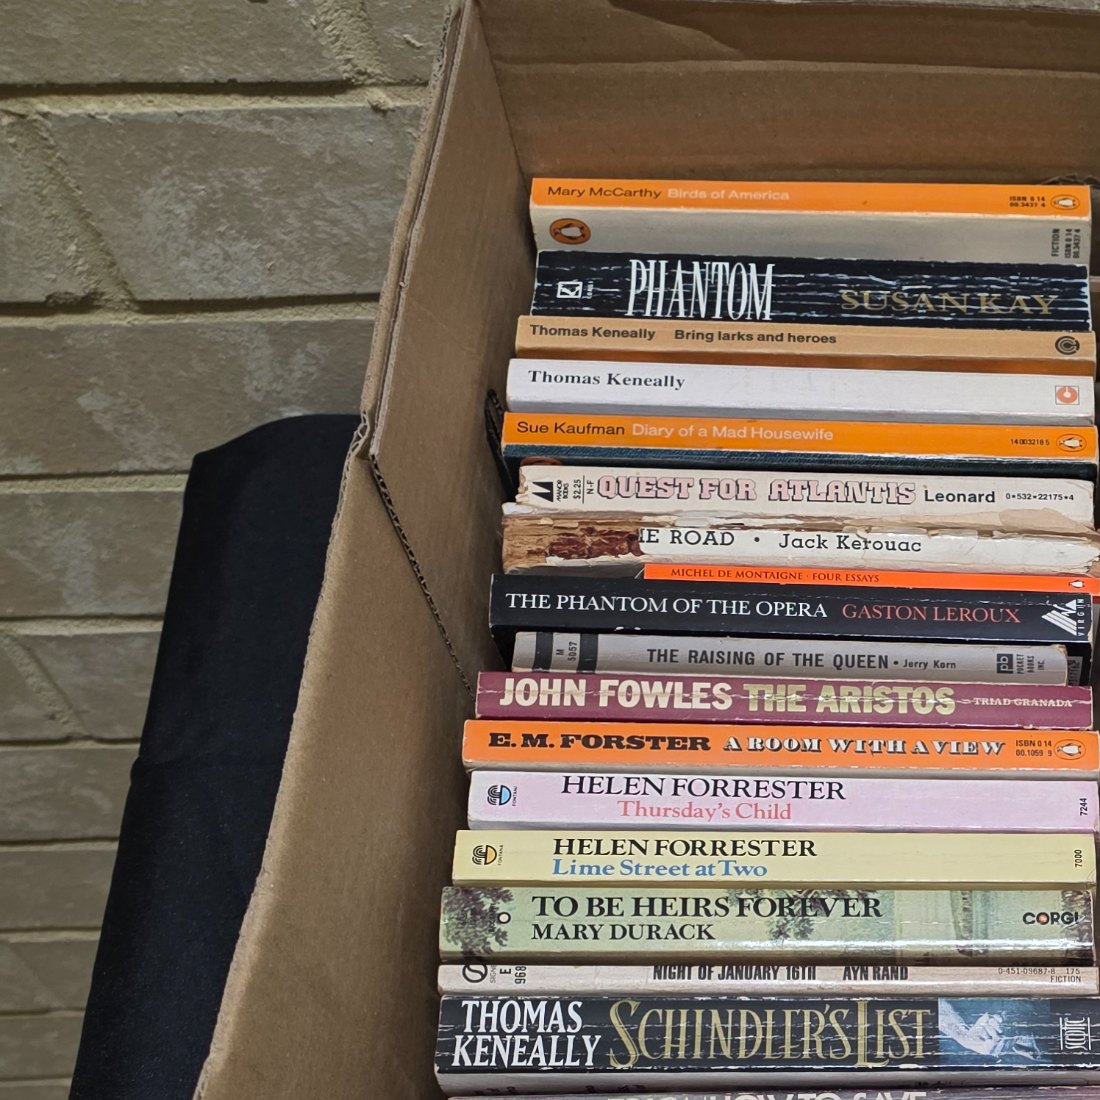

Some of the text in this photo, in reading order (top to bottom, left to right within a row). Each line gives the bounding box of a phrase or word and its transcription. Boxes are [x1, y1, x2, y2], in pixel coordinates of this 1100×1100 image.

[624, 259, 776, 321] PHANTOM
[840, 289, 968, 315] SUSAN
[978, 293, 1059, 315] KAY
[530, 325, 837, 343] Thomas Keneally Bring larks and heroes
[528, 370, 685, 390] Thomas Keneally
[597, 475, 995, 505] QUEST FOR ATLANTIS Leonard
[671, 568, 879, 582] MICHEL DE MONTAIGNE FOUR ESSAYS
[506, 593, 1021, 624] THE PHANTOM OF THE OPERA GASTON LEROUX
[561, 775, 846, 800] HELEN FORRESTER
[1080, 798, 1088, 816] 7244
[462, 1000, 582, 1033] THOMAS
